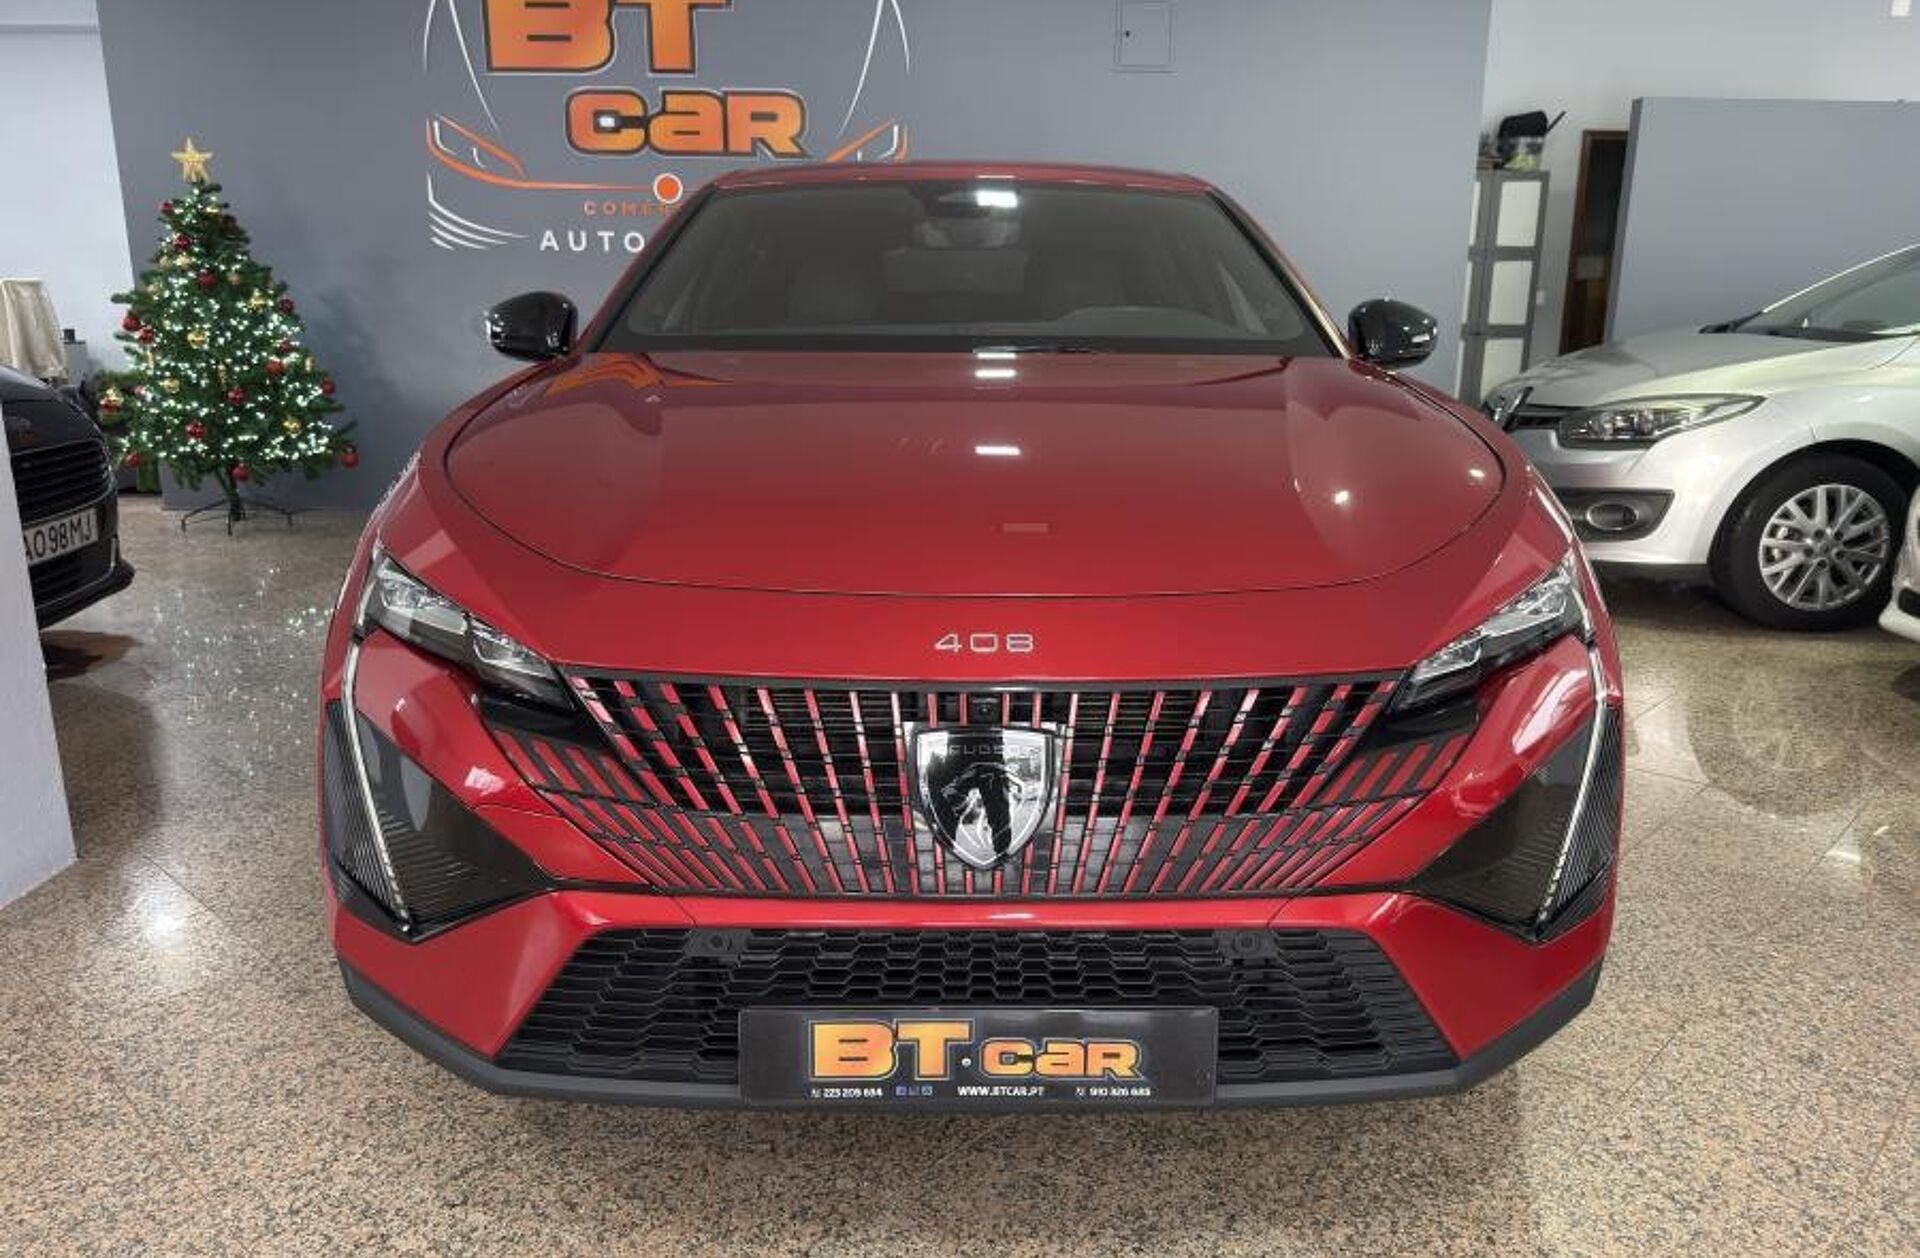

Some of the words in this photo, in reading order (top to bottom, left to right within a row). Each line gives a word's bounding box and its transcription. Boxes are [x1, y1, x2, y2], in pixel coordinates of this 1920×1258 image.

[483, 0, 732, 75] BT
[540, 230, 645, 252] AUTO
[935, 633, 1034, 653] 408
[809, 1019, 974, 1079] BT
